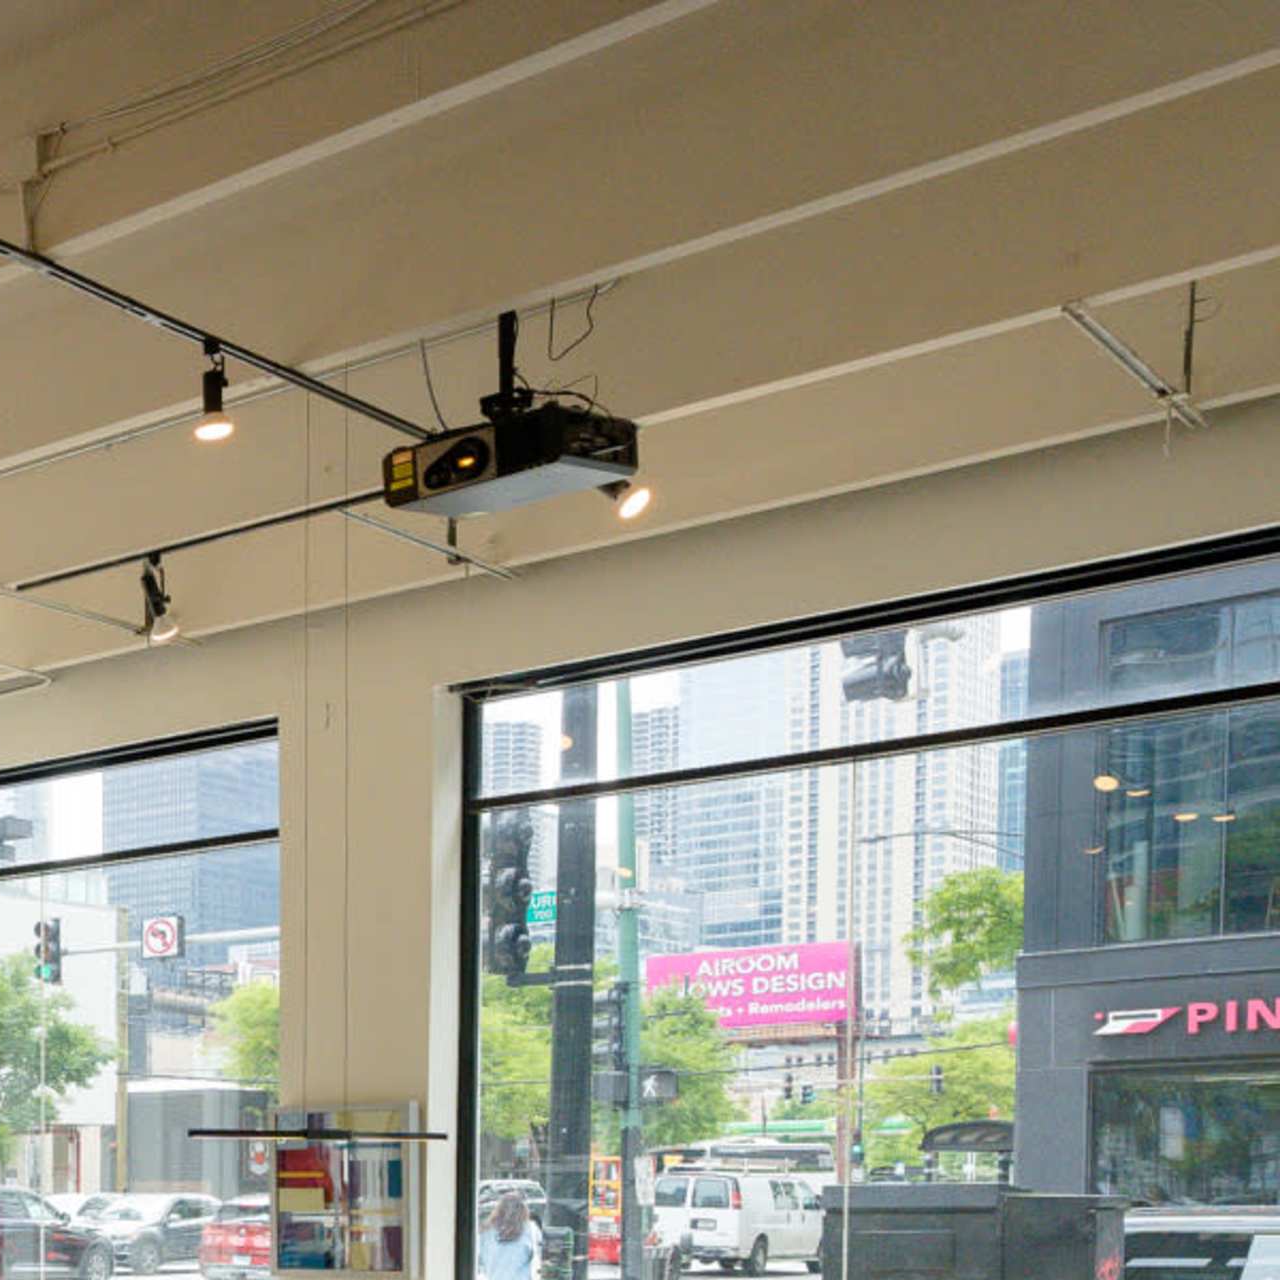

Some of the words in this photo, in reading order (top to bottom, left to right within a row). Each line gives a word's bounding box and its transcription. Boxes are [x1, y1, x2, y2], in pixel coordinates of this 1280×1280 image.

[696, 952, 799, 977] AIROOM
[678, 977, 745, 999] OWS
[751, 970, 845, 996] DESIGN
[748, 997, 845, 1015] Remodelers
[1187, 996, 1280, 1035] PIN
